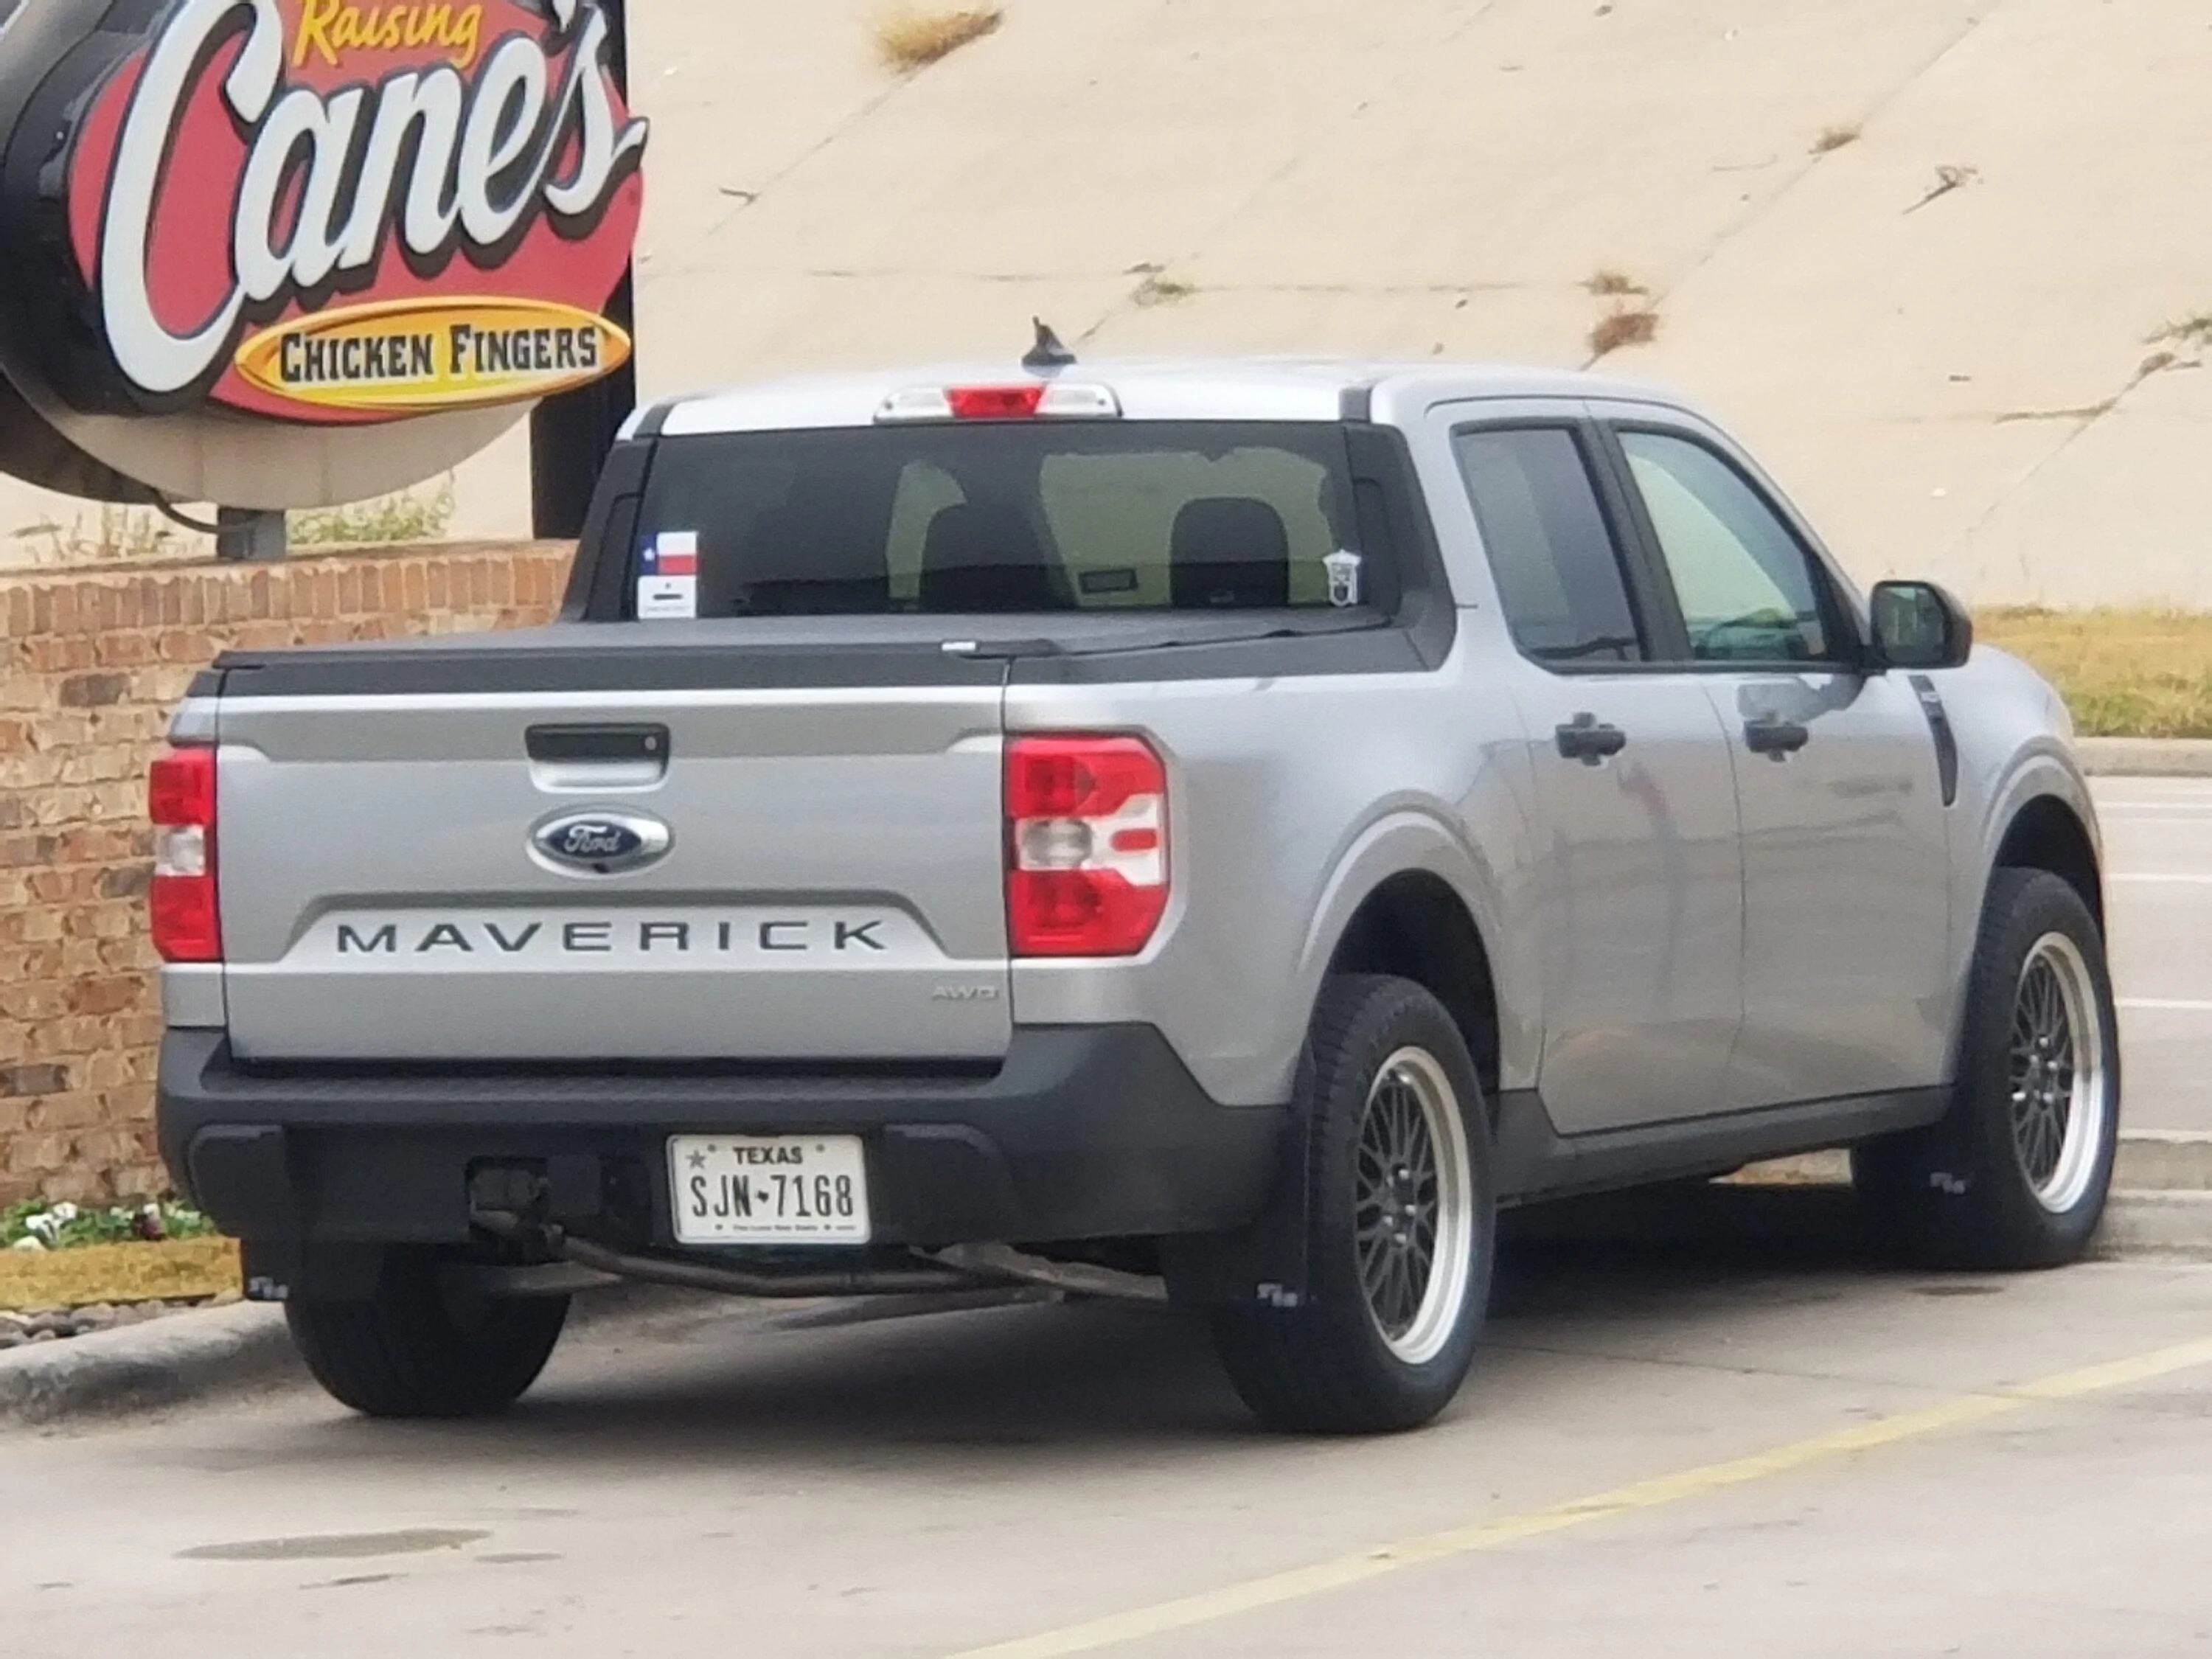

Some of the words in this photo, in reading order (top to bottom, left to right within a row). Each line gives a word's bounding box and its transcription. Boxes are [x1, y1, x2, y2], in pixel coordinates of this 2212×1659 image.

[292, 0, 483, 69] Raising
[101, 0, 648, 392] Cane's
[279, 332, 434, 383] CHICKEN
[449, 323, 599, 374] FINGERS
[564, 824, 622, 853] Ford
[337, 919, 887, 953] MAVERICK
[733, 1146, 804, 1165] TEXAS
